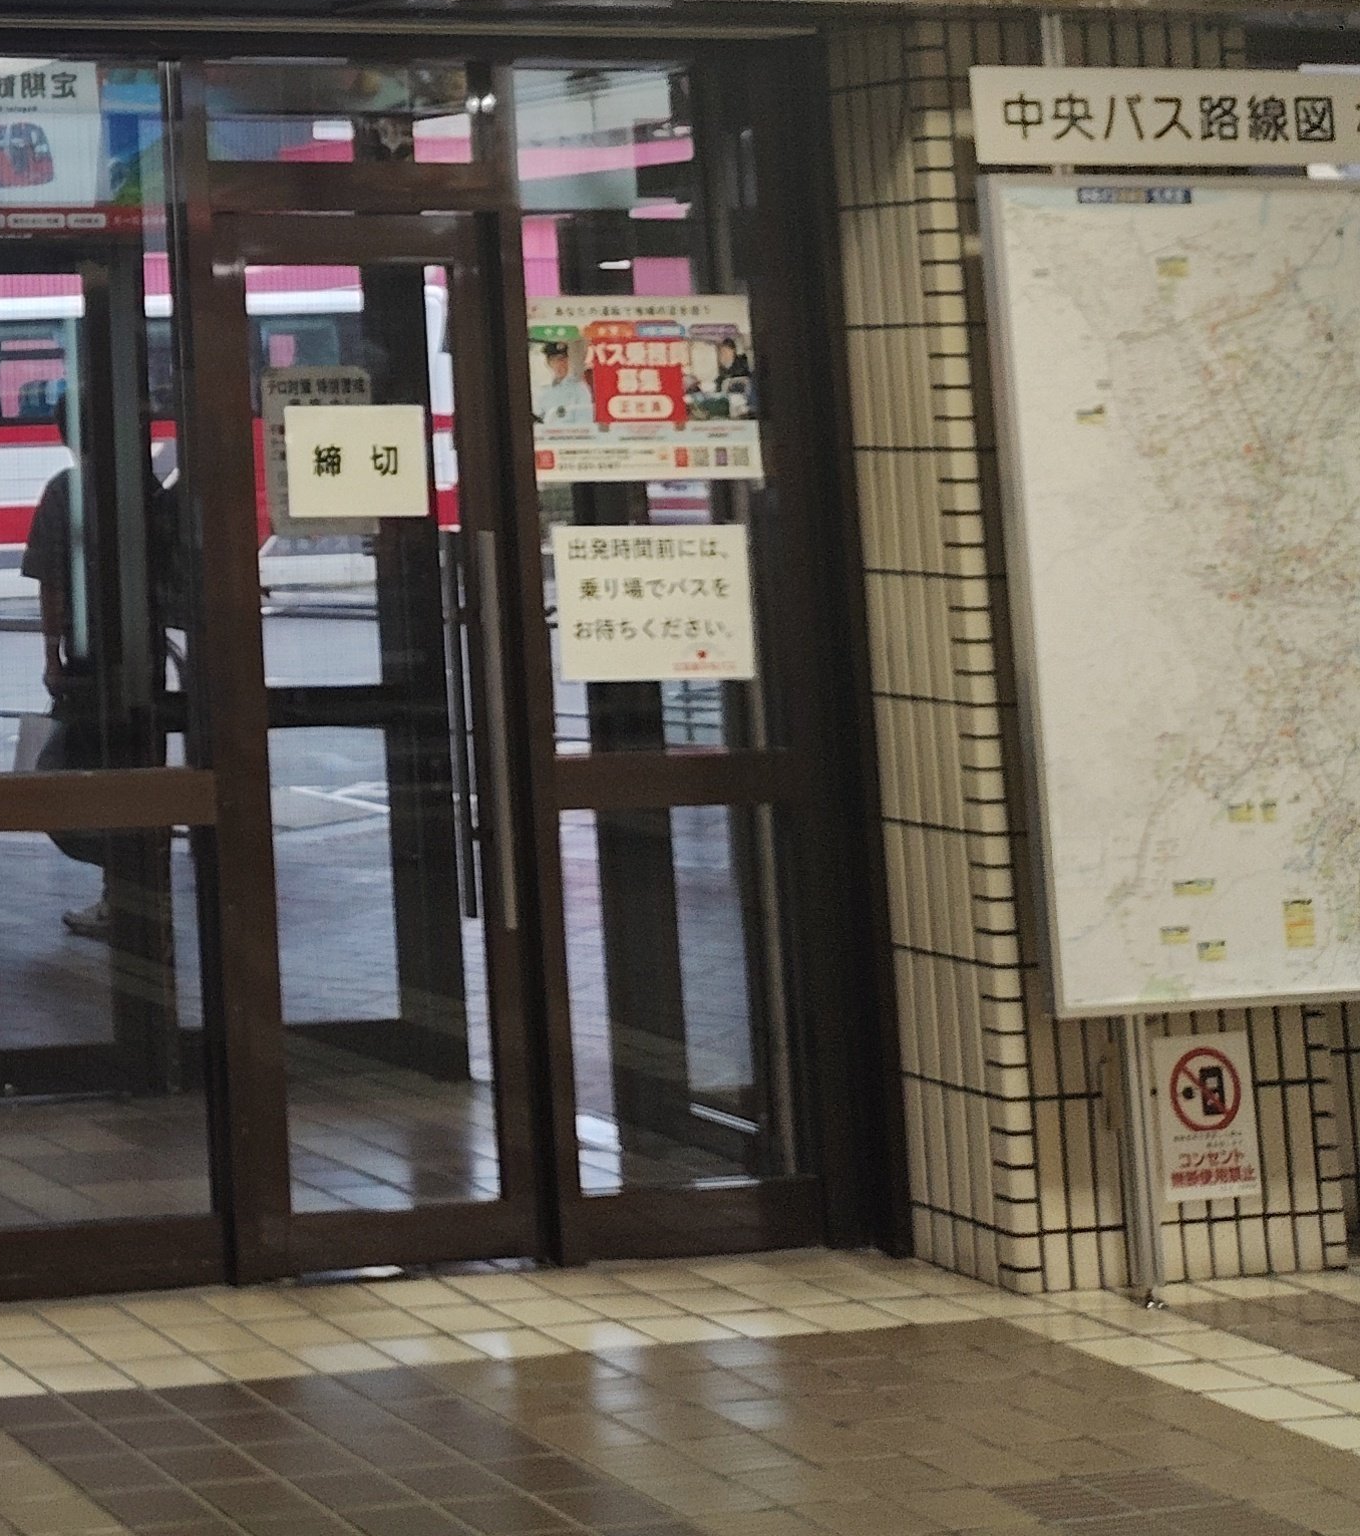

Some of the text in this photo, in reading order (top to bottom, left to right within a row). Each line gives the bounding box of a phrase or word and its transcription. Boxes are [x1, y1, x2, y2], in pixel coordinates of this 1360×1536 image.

[1003, 91, 1334, 142] 中央バス路線図
[567, 537, 730, 560] 出発時間前には、
[580, 577, 729, 600] 乗り場でバスを
[572, 619, 734, 641] お待ちください。
